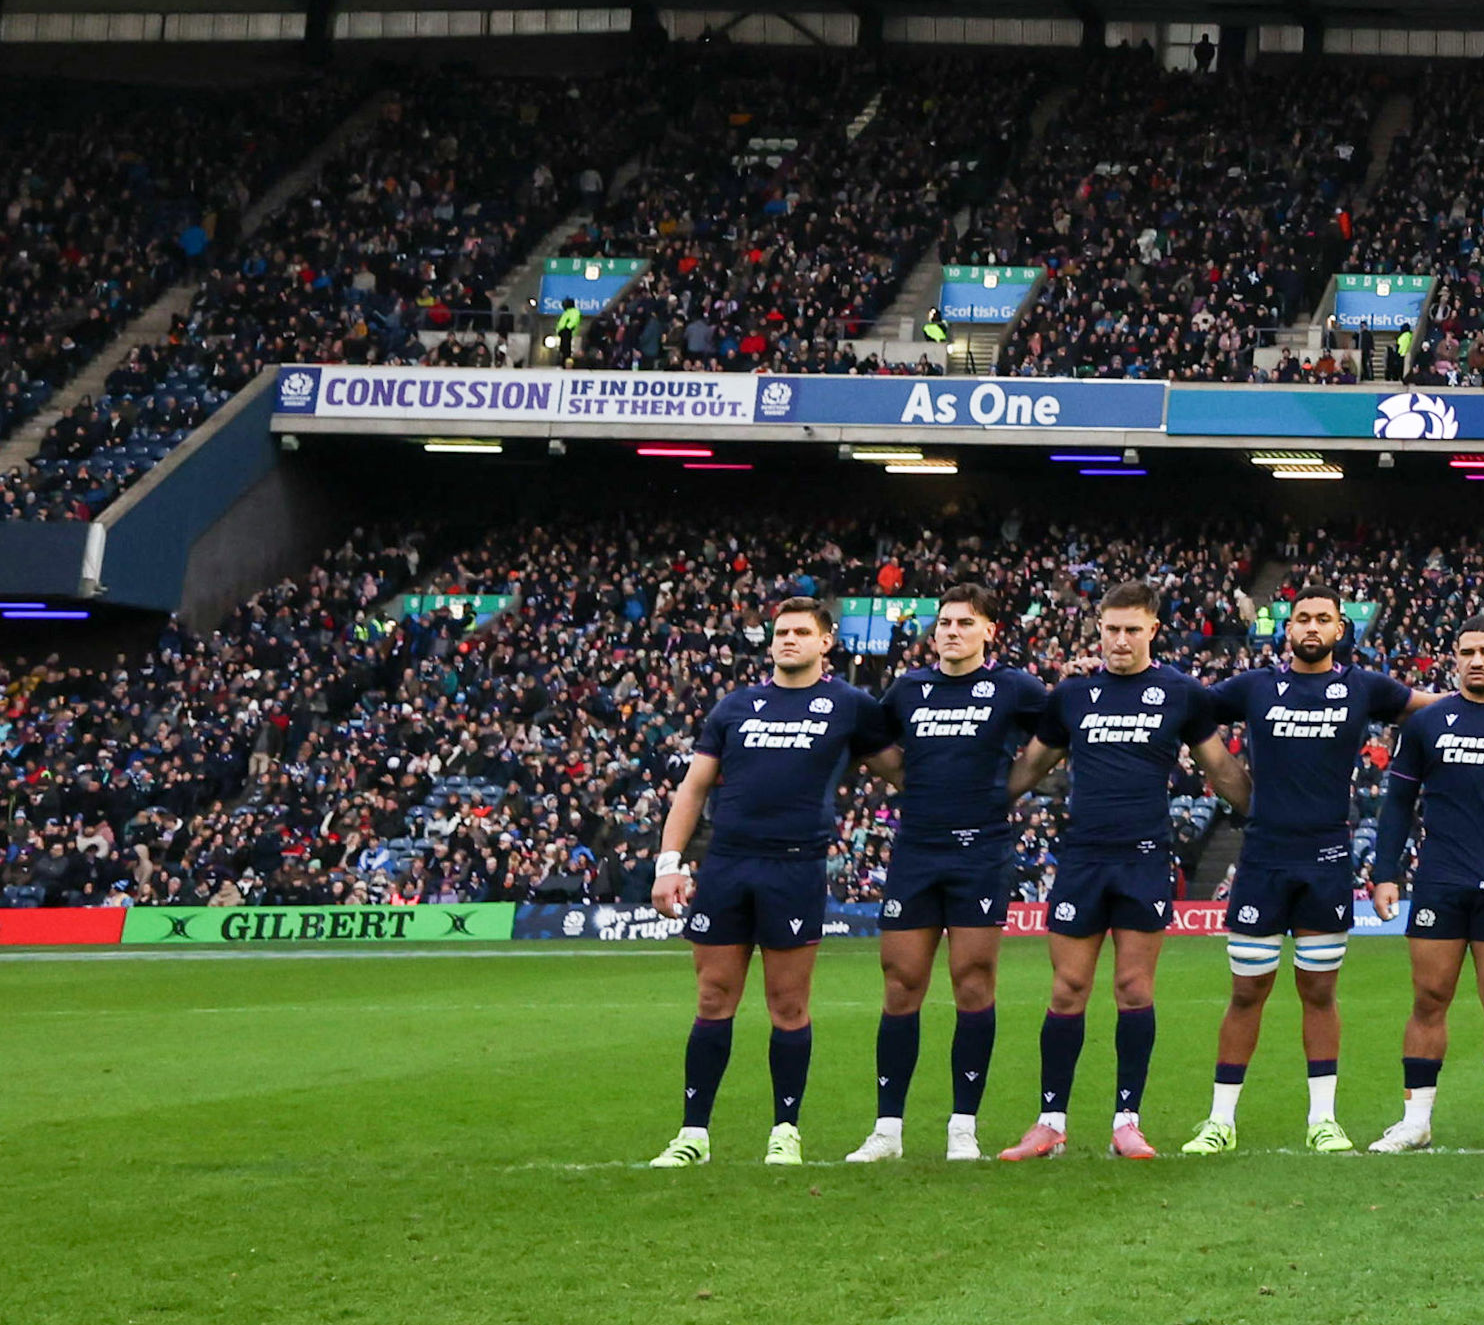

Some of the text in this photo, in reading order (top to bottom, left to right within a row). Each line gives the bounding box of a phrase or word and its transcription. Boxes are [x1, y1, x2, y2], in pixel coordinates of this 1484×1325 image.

[325, 377, 553, 411] CONCUSSION
[570, 380, 723, 399] IF IN DOUBT,
[568, 398, 612, 415] SIT
[617, 399, 687, 416] THEM
[691, 399, 747, 418] OUT.
[901, 382, 1060, 426] As One
[910, 706, 992, 724] Arnold
[1079, 713, 1162, 730] Arnold
[1264, 705, 1348, 723] Arnold
[738, 718, 829, 736] Arnold
[915, 720, 978, 737] Clark
[1087, 726, 1150, 744] Clark
[1271, 720, 1337, 739] Clark
[743, 731, 815, 749] Clark
[220, 911, 415, 941] GILBERT
[599, 917, 687, 941] of rugb
